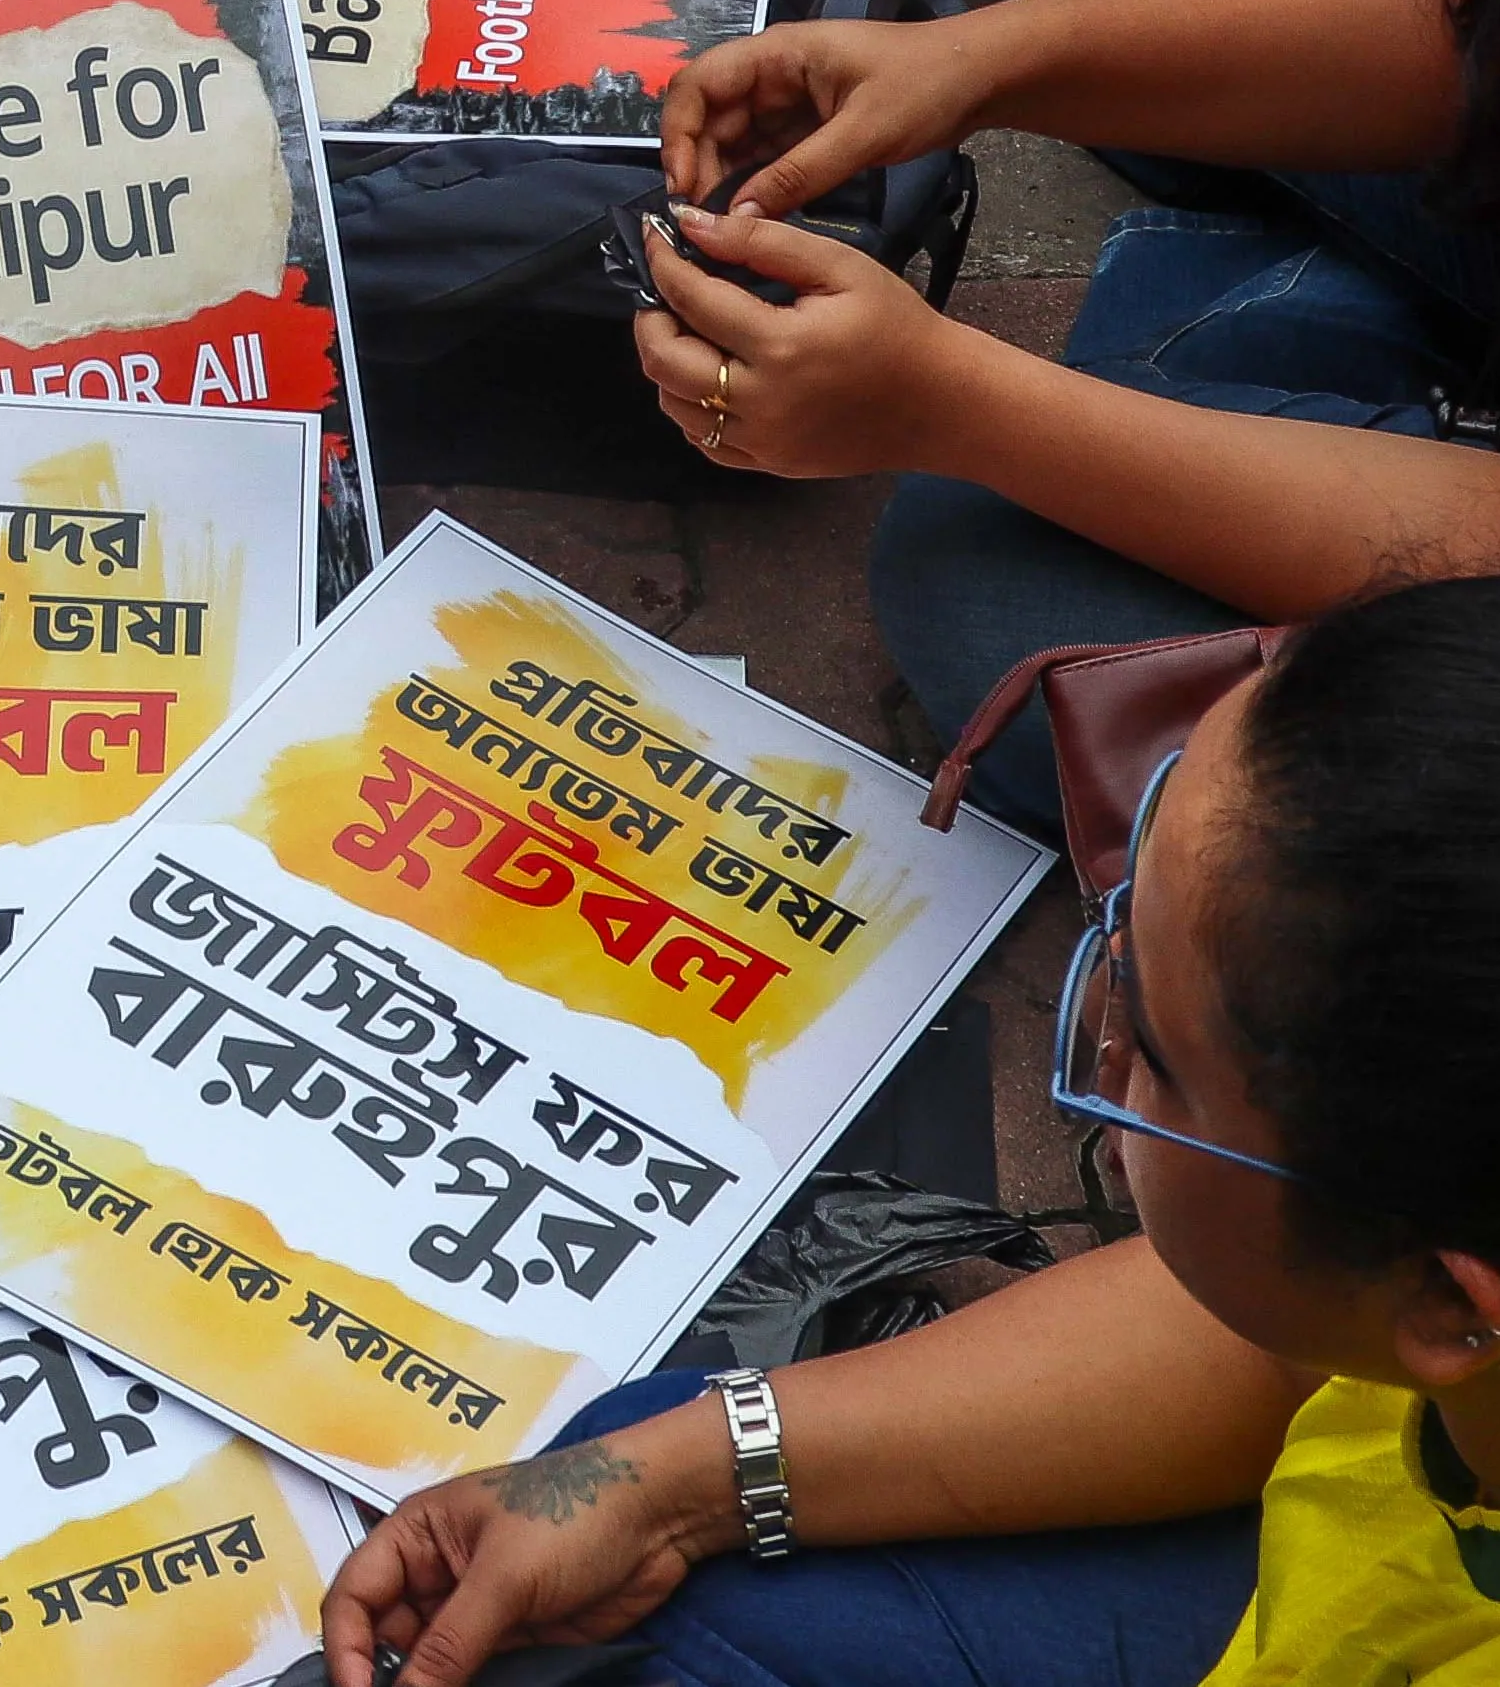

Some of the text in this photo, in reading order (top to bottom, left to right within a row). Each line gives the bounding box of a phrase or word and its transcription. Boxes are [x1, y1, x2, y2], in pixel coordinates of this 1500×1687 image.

[67, 45, 220, 147] for
[189, 333, 268, 406] All
[29, 595, 208, 656] ভাষা
[394, 673, 868, 955] অন্যতম ভাষা
[489, 659, 852, 868] প্রতিবাদের
[332, 746, 792, 1024] ফুটবল
[87, 936, 655, 1304] বারুইপুর
[129, 853, 739, 1225] জাস্টিস ফর
[150, 1221, 292, 1304] হোক
[290, 1290, 506, 1430] সকলের
[28, 1515, 266, 1629] সকলের
